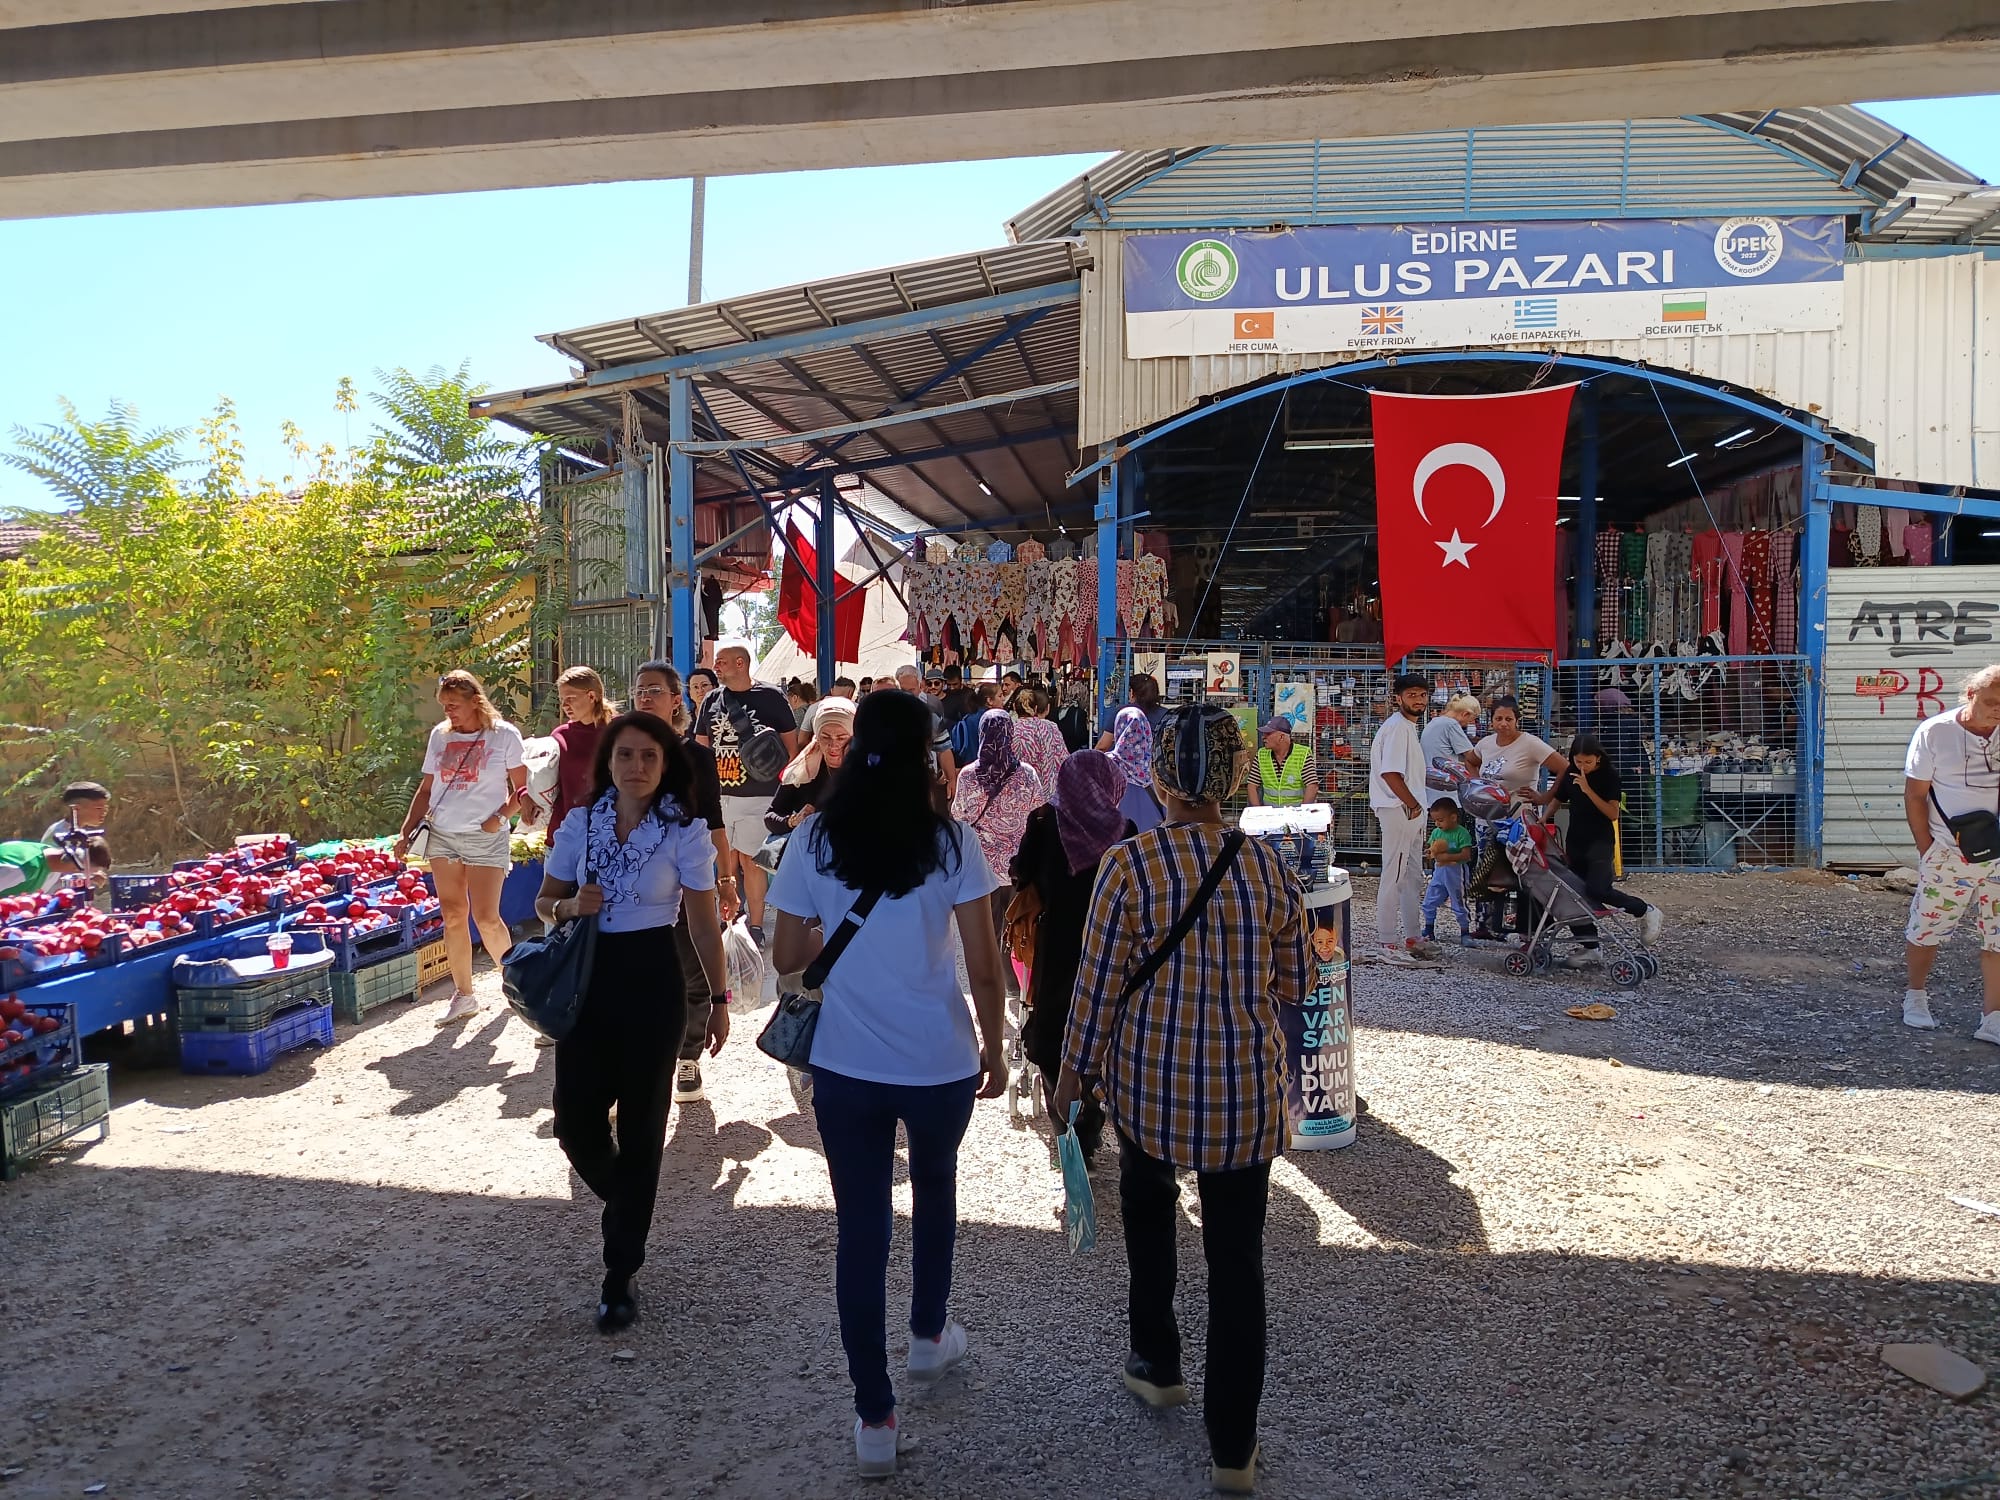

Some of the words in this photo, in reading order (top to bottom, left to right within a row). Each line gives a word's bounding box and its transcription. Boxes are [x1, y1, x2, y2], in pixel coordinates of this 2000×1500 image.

[1411, 226, 1518, 255] EDİRNE
[1722, 235, 1777, 254] UPEK
[1275, 261, 1432, 301] ULUS
[1454, 249, 1674, 293] PAZARI
[1347, 338, 1381, 347] EVERY
[1381, 336, 1416, 346] FRIDAY
[1645, 325, 1682, 335] ВСЕКИ
[1228, 343, 1248, 351] HER
[1250, 342, 1279, 351] CUMA
[1848, 600, 1999, 646] ATRE
[1302, 984, 1345, 1007] SEN
[1302, 1008, 1345, 1029] VAR
[1302, 1025, 1349, 1048] SAN,
[1300, 1049, 1348, 1073] UMU
[1301, 1068, 1349, 1092] DUM
[1301, 1089, 1349, 1113] VAR!
